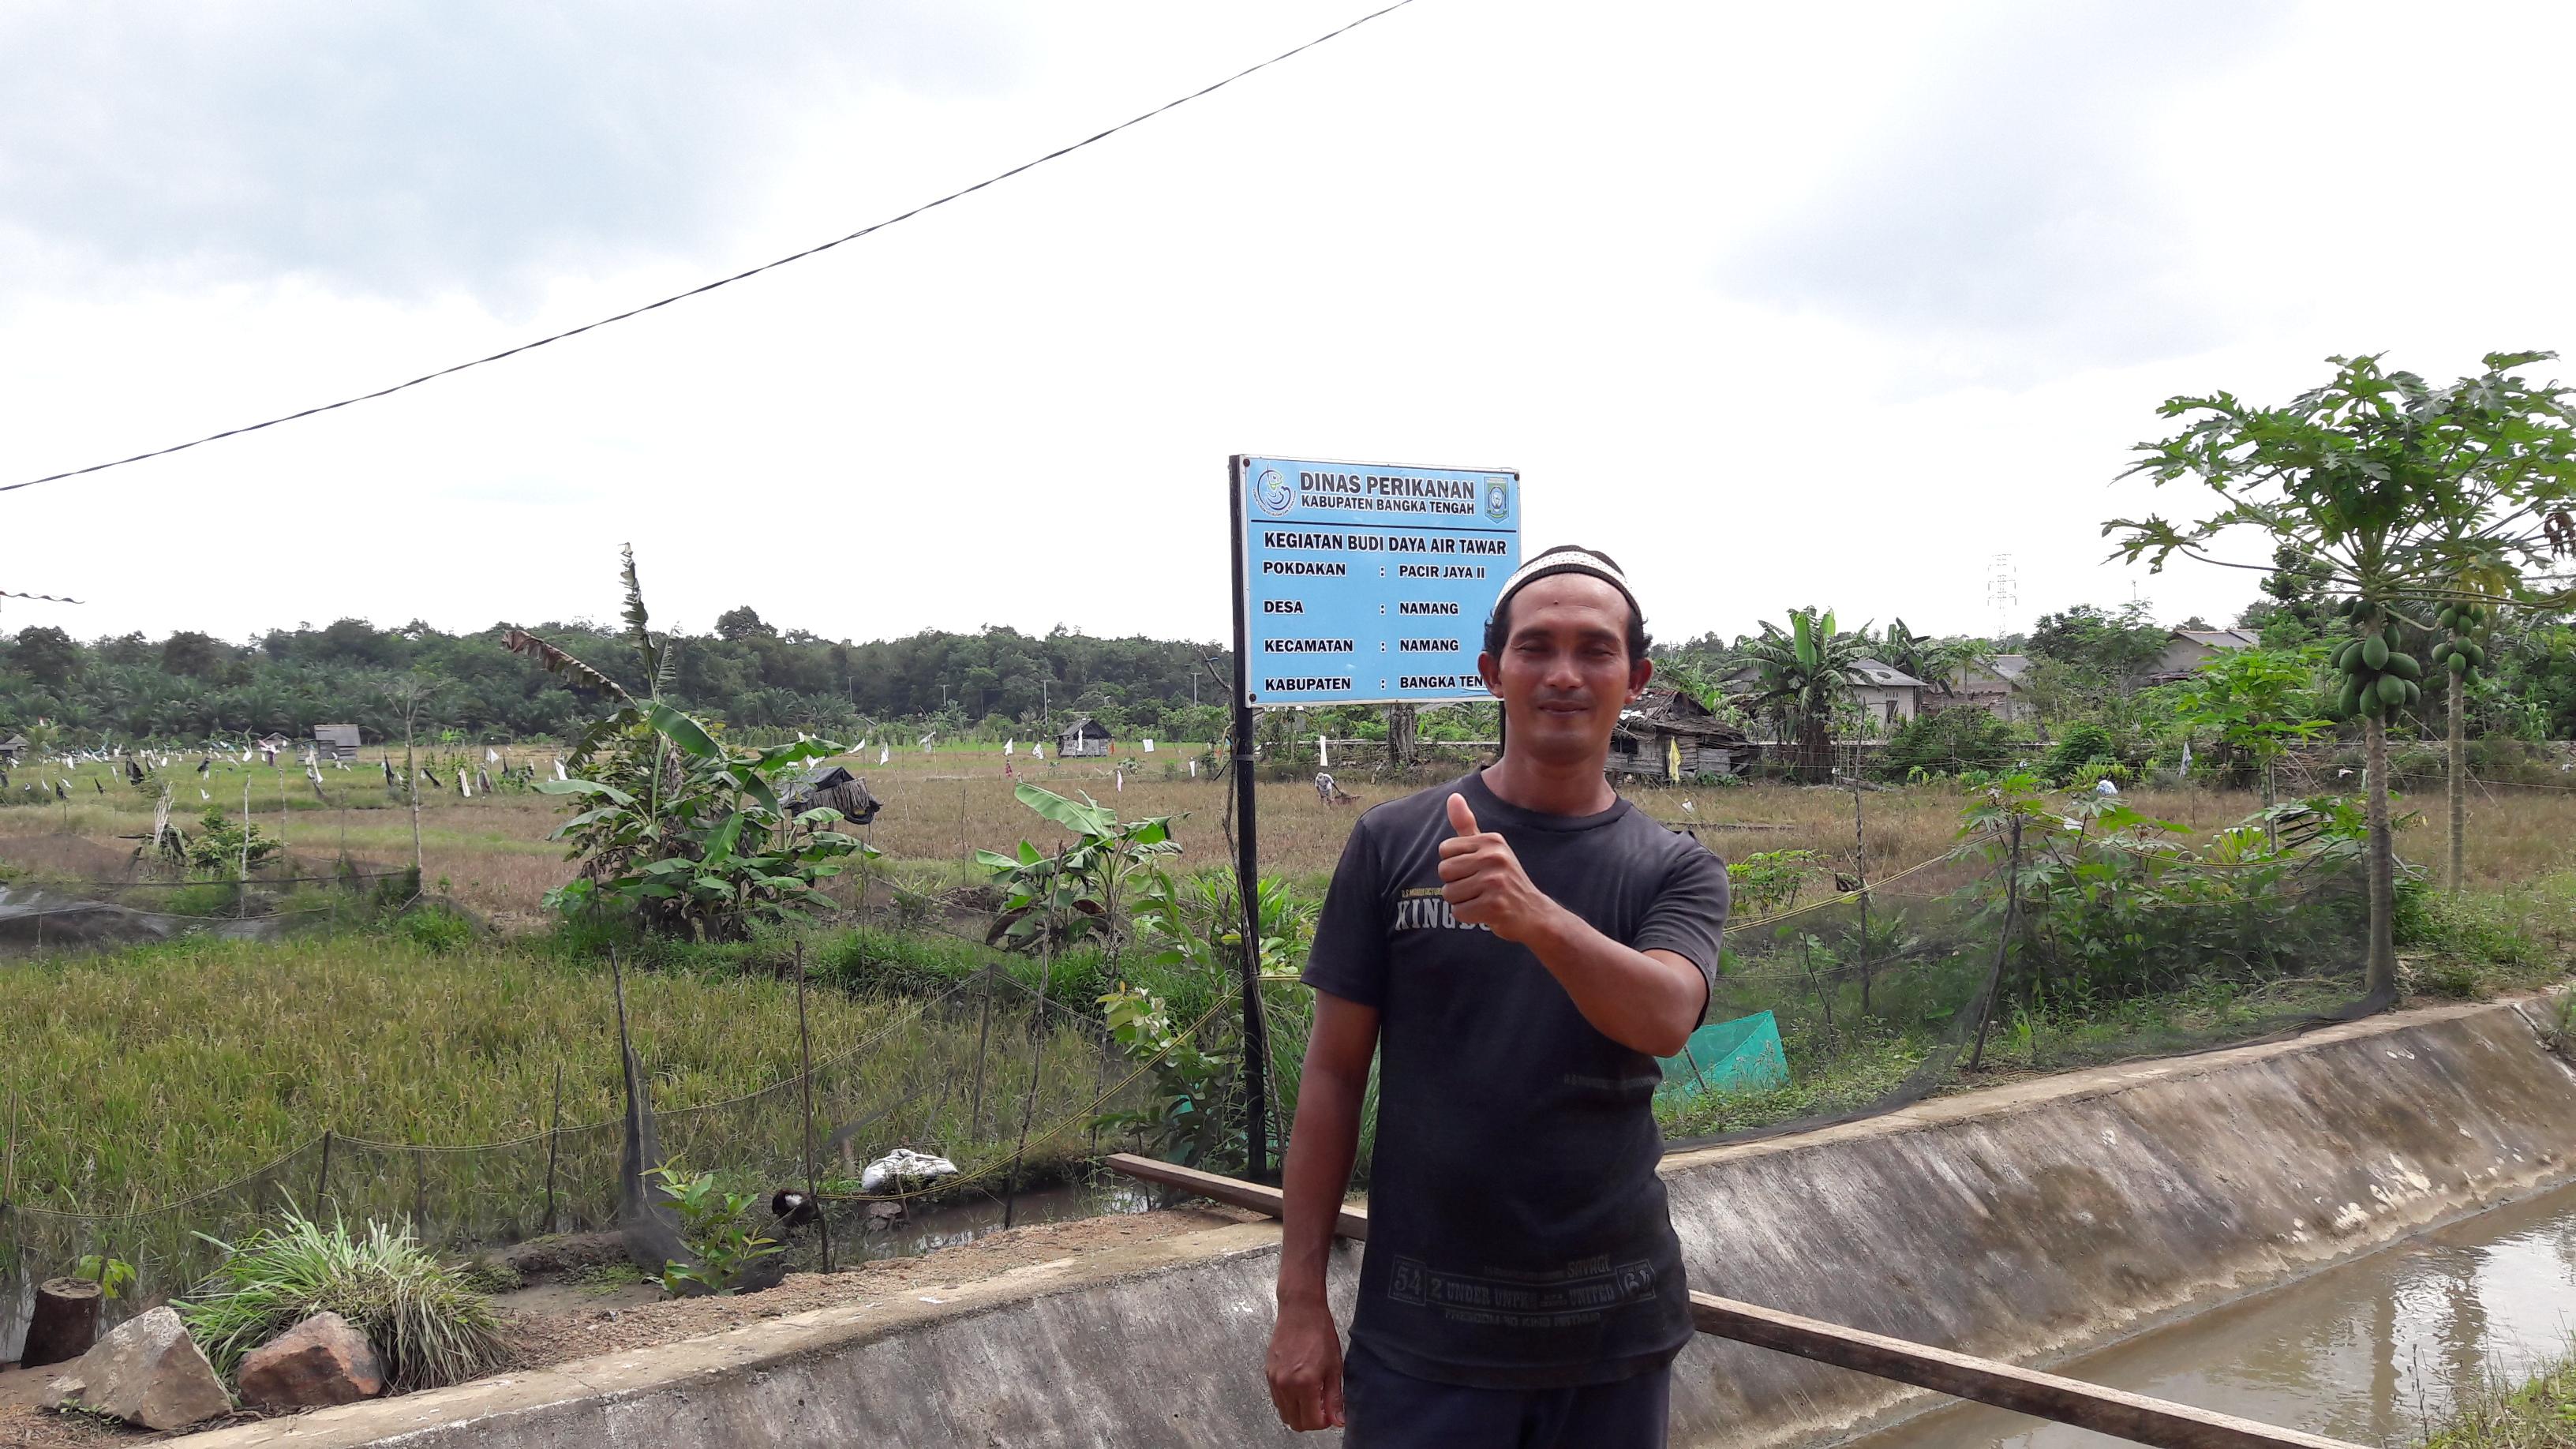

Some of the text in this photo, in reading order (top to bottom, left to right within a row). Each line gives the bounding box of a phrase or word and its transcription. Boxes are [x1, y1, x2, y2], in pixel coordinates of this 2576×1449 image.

[1300, 472, 1474, 500] DINAS PERIKANAN
[1301, 495, 1372, 511] KABUPATEN
[1376, 499, 1426, 512] BANGKA
[1429, 501, 1474, 515] TENGAH
[1264, 532, 1506, 554] KEGIATAN BUDI DAYA AIR TAWAR
[1263, 561, 1346, 575] POKDAKAN
[1399, 565, 1440, 577] PACIR
[1443, 566, 1473, 578] JAYA
[1477, 567, 1485, 578] II
[1264, 601, 1304, 613] DESA
[1399, 602, 1458, 615] NAMANG
[1264, 640, 1353, 652] KECAMATAN
[1399, 639, 1459, 651] NAMANG
[1264, 678, 1351, 691] KABUPATEN
[1399, 676, 1456, 688] BANGKA
[1458, 676, 1483, 687] TEN
